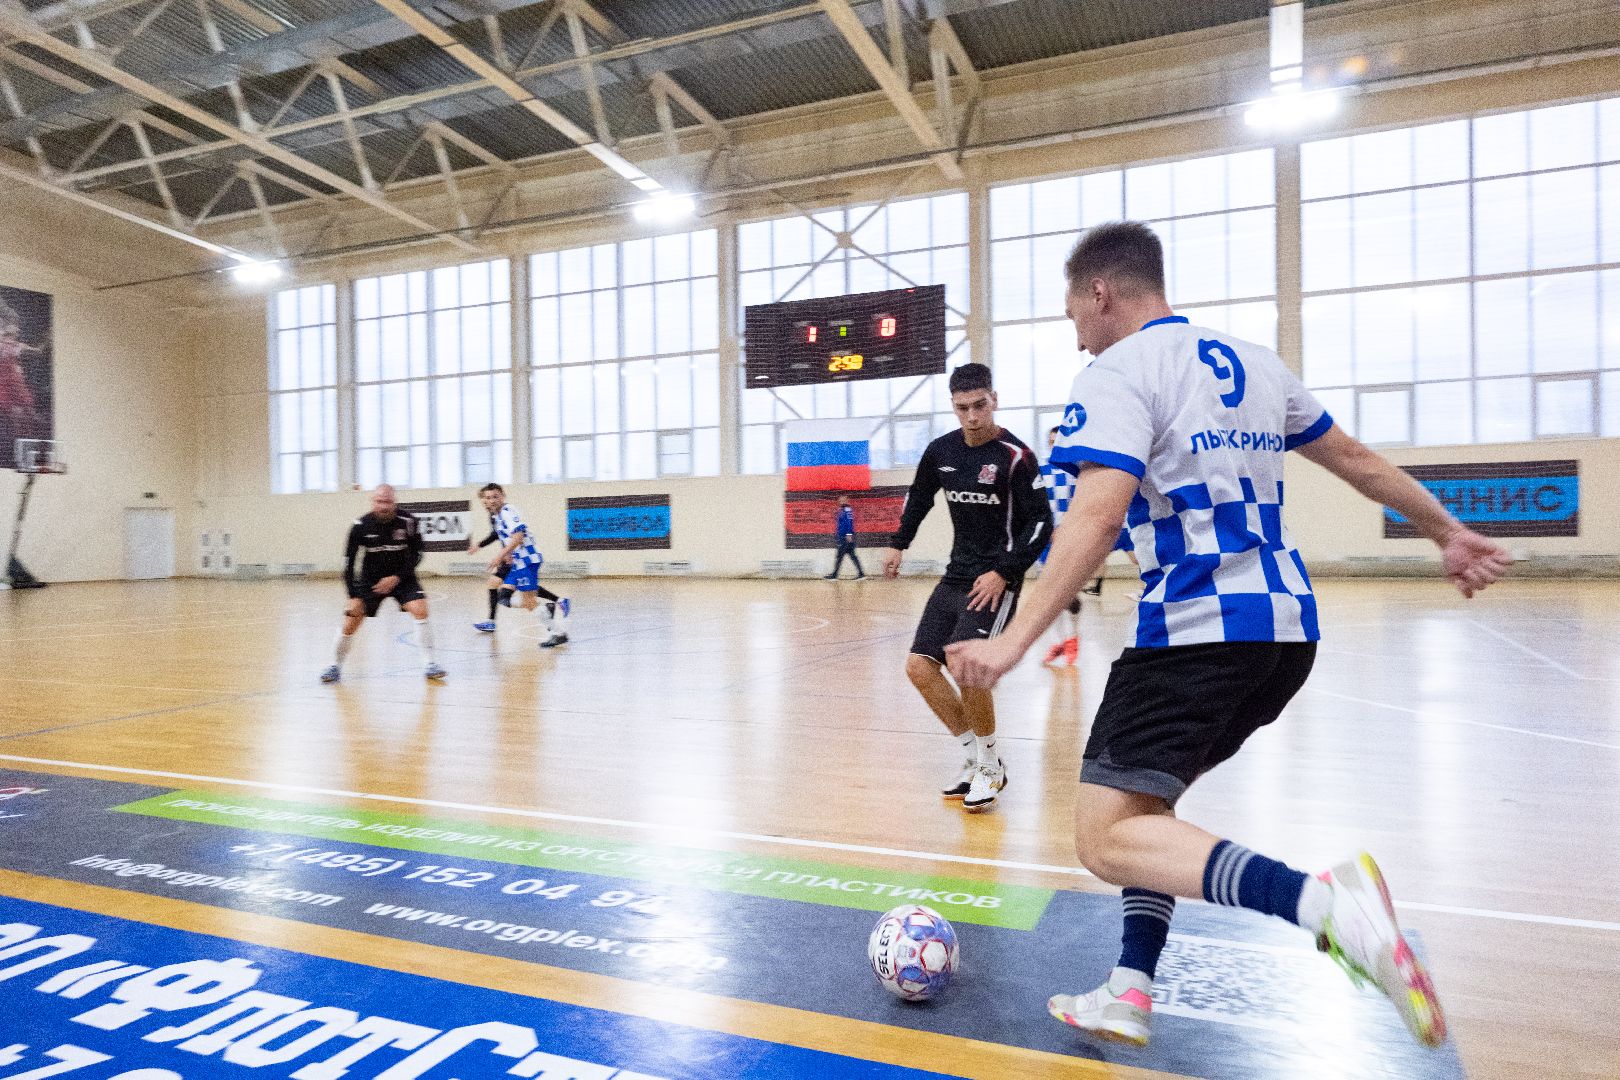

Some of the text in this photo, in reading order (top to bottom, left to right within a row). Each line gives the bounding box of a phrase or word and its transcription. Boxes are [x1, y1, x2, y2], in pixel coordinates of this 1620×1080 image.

[808, 326, 817, 343] 1
[1198, 338, 1246, 408] 9
[1429, 485, 1564, 516] ННИС
[275, 848, 408, 877] (495)
[403, 865, 497, 888] 152
[501, 878, 581, 900] 04
[763, 871, 1002, 908] ПЛАСТИКОВ
[362, 902, 728, 970] www.orgplex.cm
[878, 922, 896, 976] SELECT
